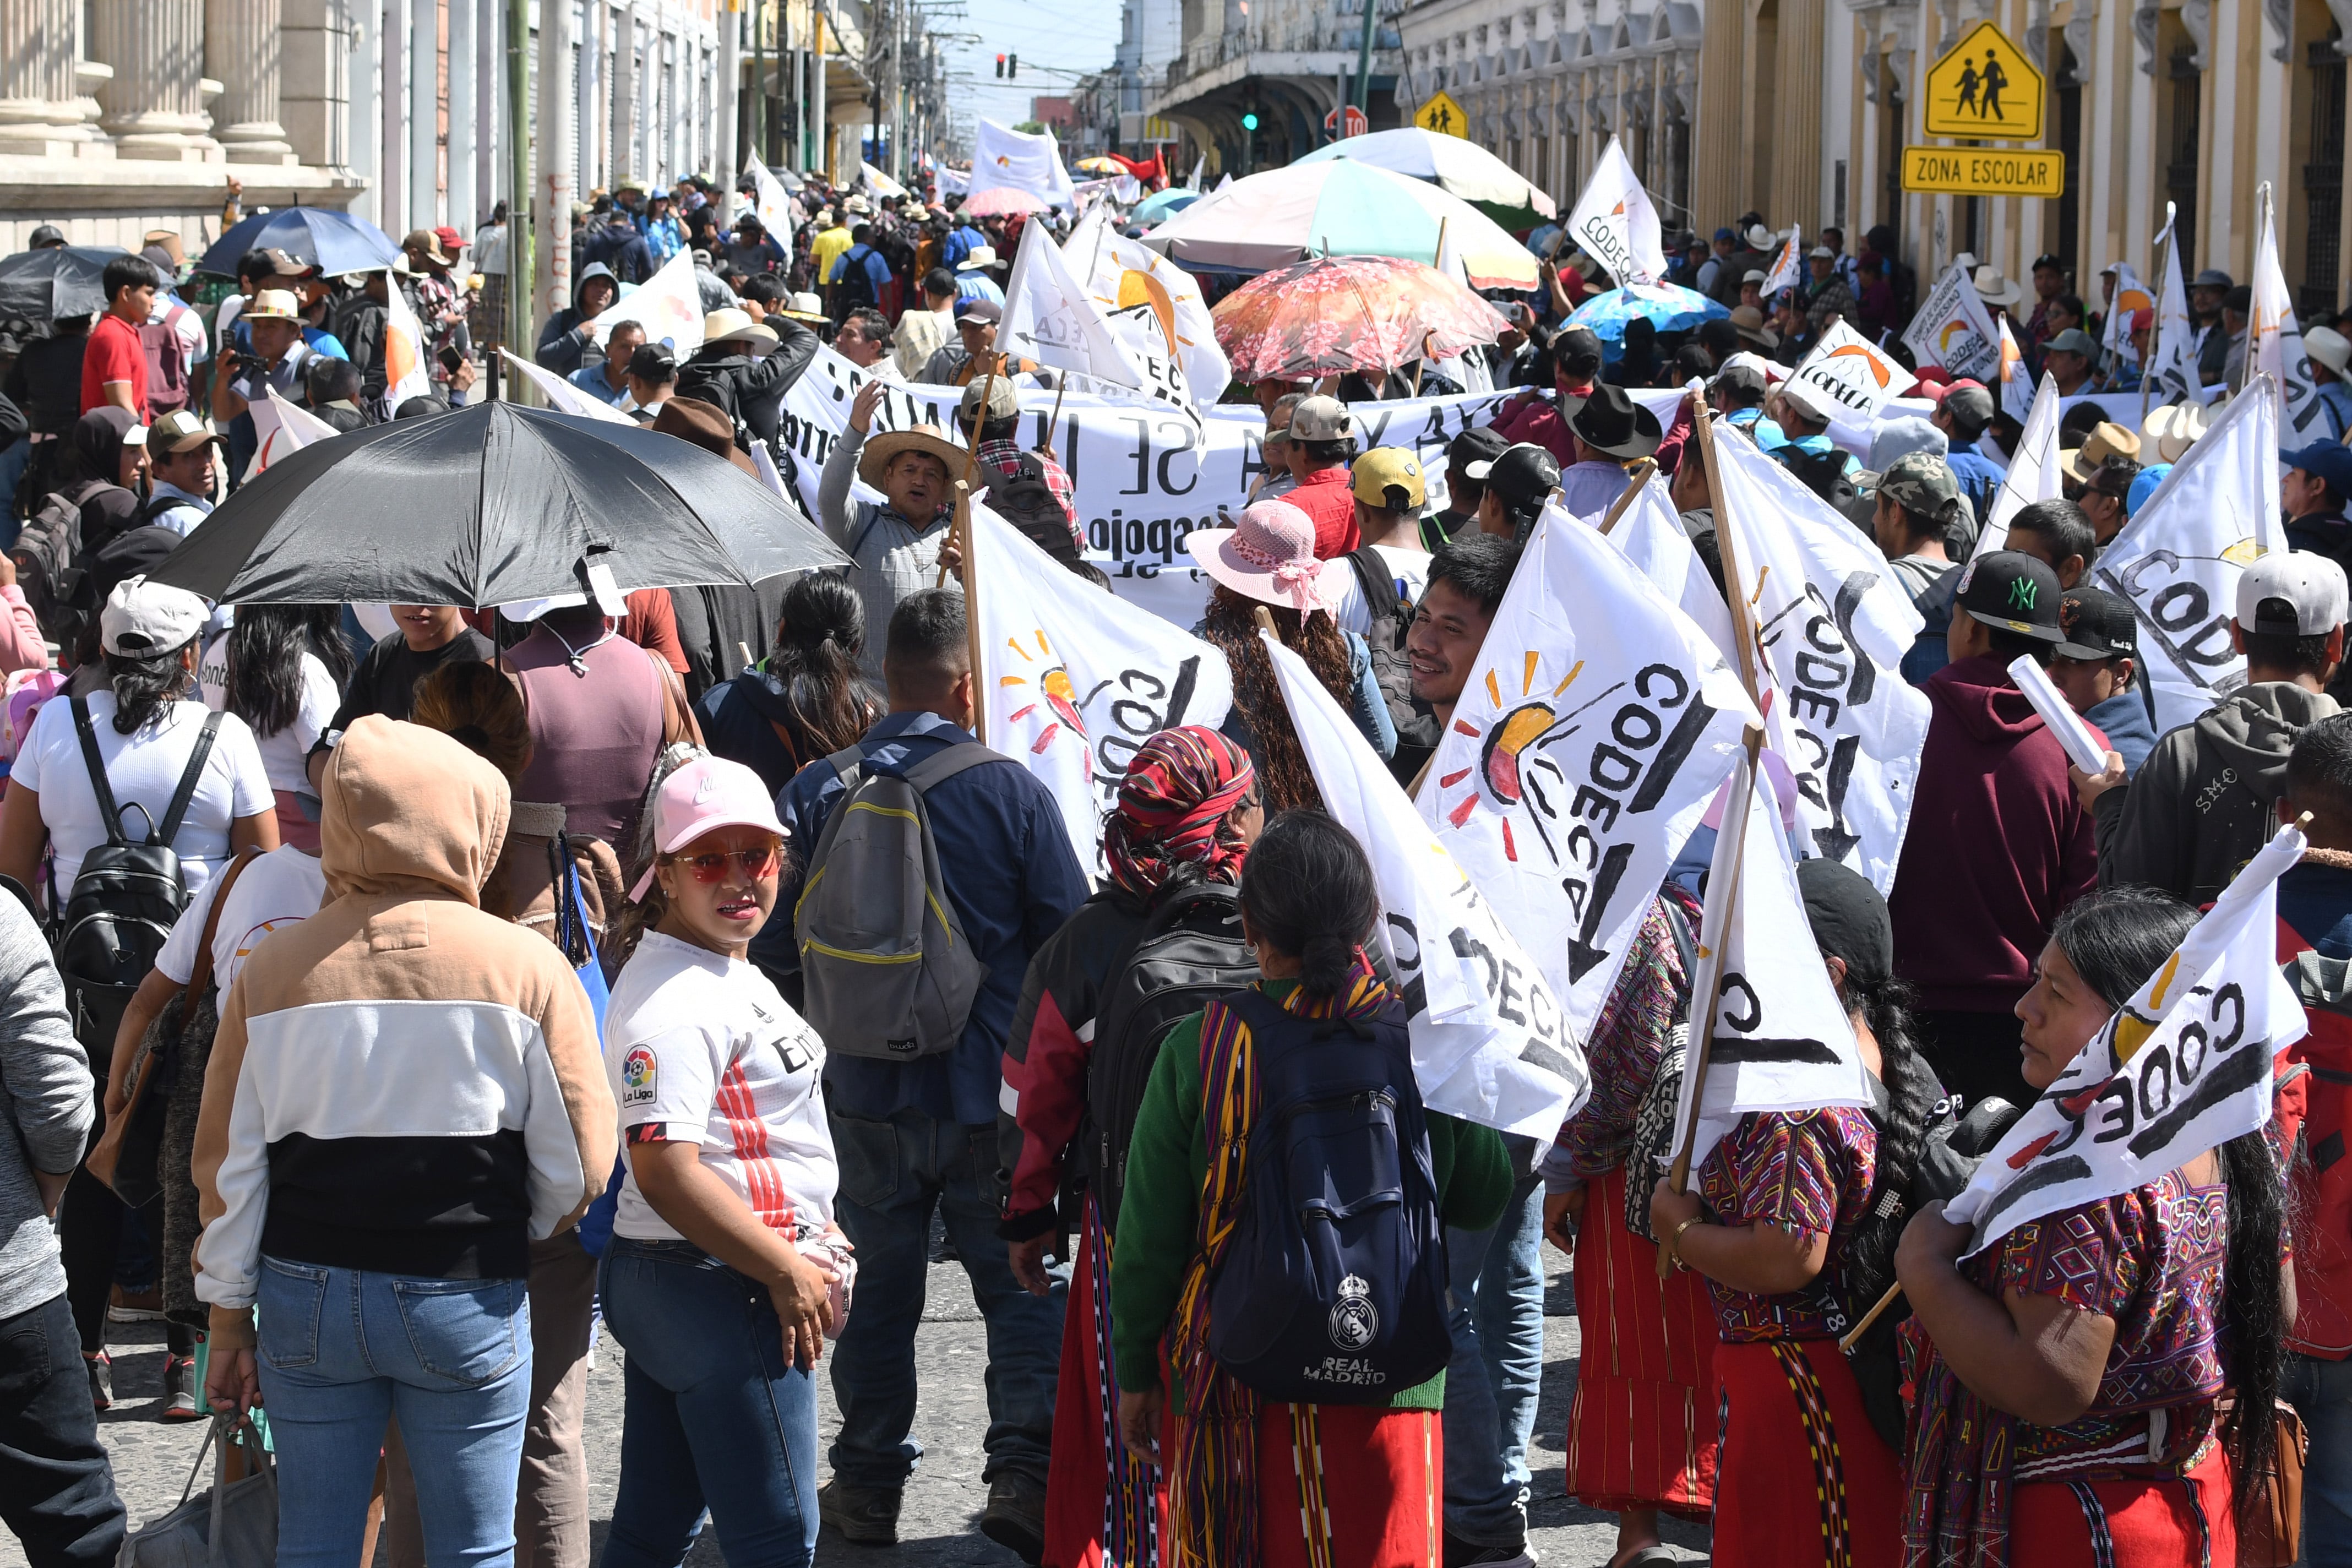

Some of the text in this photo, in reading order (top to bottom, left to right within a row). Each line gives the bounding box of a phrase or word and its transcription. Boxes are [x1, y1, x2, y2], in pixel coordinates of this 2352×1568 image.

[1917, 157, 2048, 186] ZONA ESCOLAR
[1945, 333, 1984, 371] CODECA
[1800, 365, 1873, 416] CODECA
[2008, 576, 2037, 611] NY
[624, 1089, 653, 1102] La Liga
[1303, 1365, 1386, 1385] MADRID
[1321, 1357, 1374, 1373] REAL
